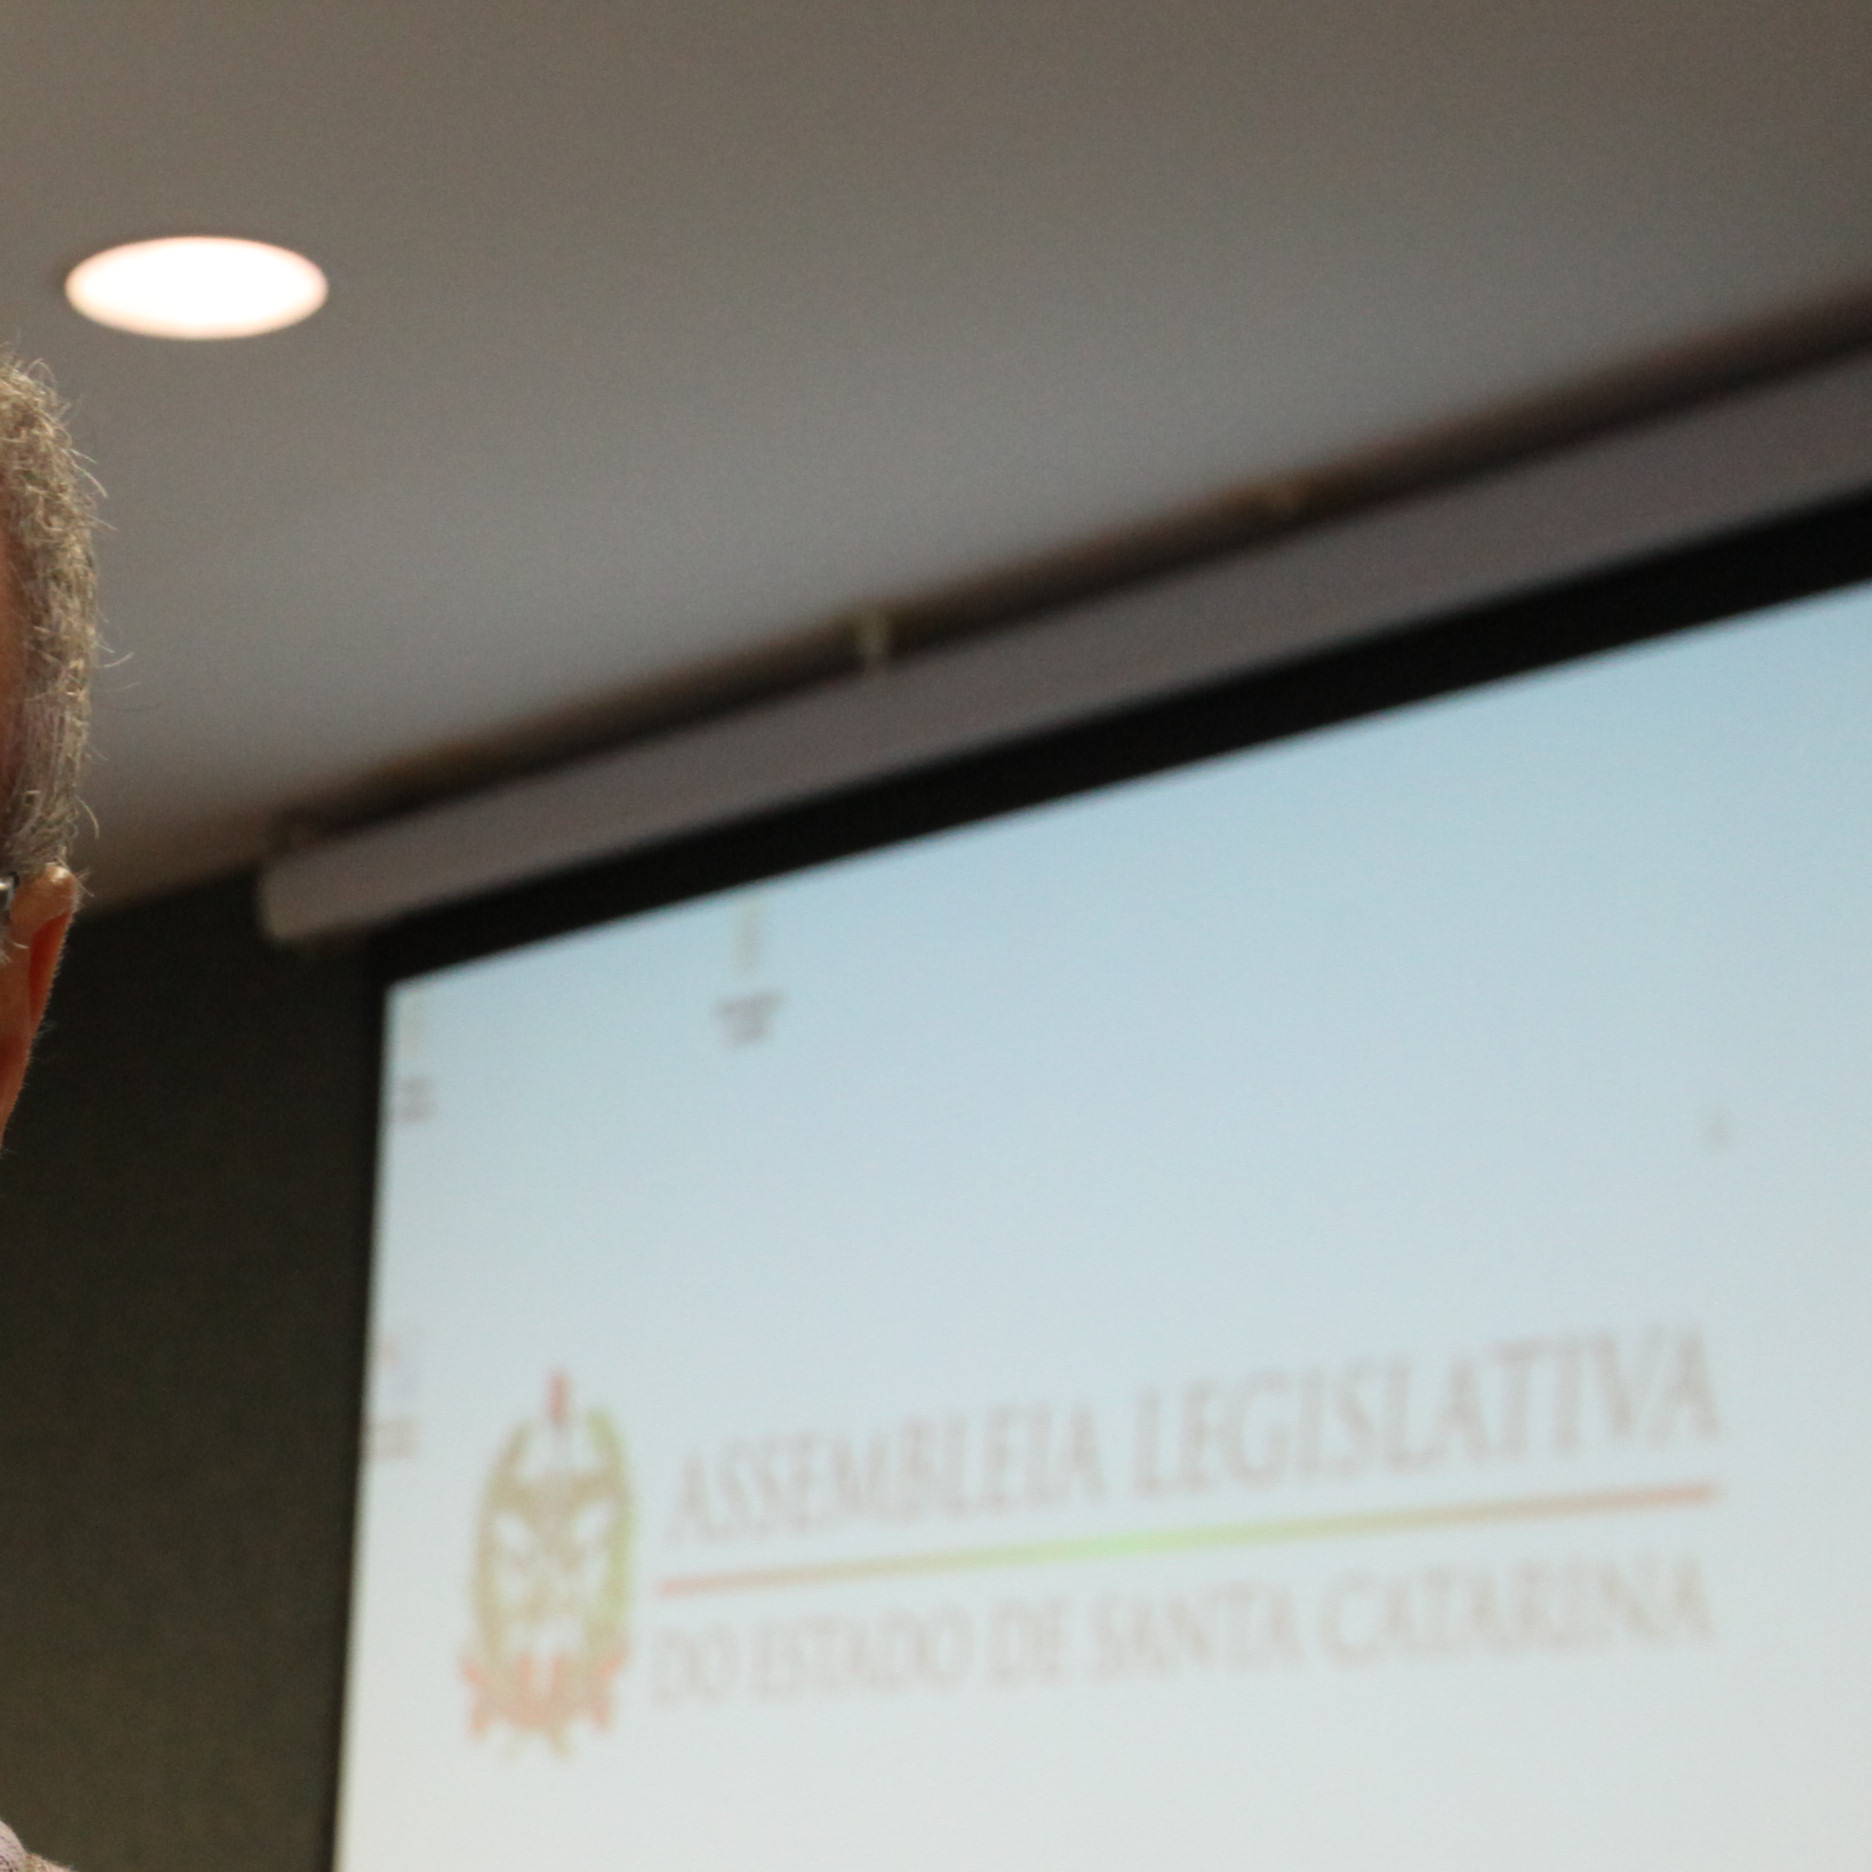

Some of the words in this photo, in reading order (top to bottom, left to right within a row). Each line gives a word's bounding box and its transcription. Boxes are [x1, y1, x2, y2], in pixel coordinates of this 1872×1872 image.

[665, 1396, 1106, 1549] ASSEMBLEIA
[1133, 1317, 1720, 1503] LEGISLATIVA
[650, 1618, 739, 1710] DO
[750, 1605, 974, 1703] ESTADO
[986, 1592, 1072, 1690] DE
[1088, 1574, 1302, 1683] SANTA
[1320, 1552, 1713, 1669] CATARINA
